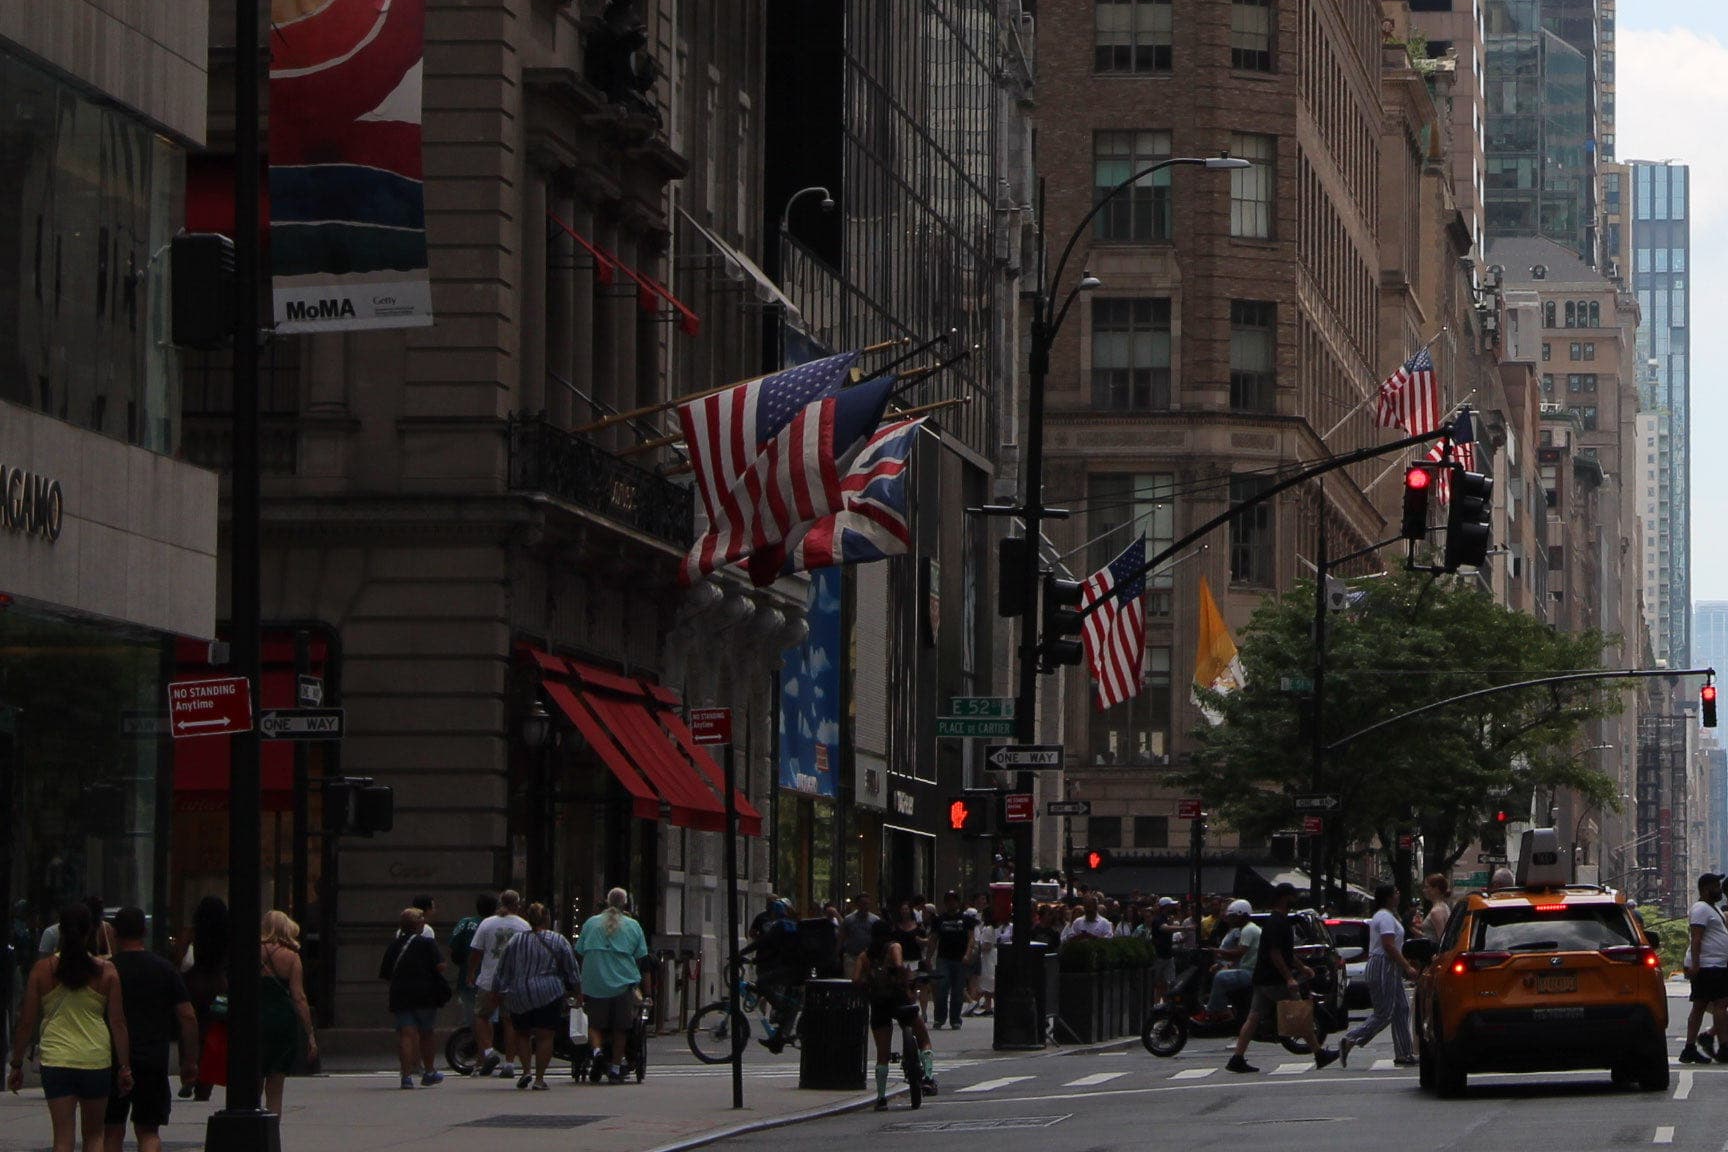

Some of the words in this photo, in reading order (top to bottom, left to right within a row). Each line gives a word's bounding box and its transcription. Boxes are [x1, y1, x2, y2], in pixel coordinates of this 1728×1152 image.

[286, 299, 356, 319] MoMA
[174, 687, 188, 698] NO
[190, 684, 236, 697] STANDING
[175, 700, 214, 712] Anytime
[952, 700, 962, 714] E
[968, 700, 990, 714] 52
[264, 719, 291, 730] ONE
[306, 718, 336, 730] WAY
[939, 723, 965, 734] PLACE
[978, 723, 1010, 734] CARTIER
[997, 753, 1018, 763] ONE
[1030, 753, 1054, 763] WAY
